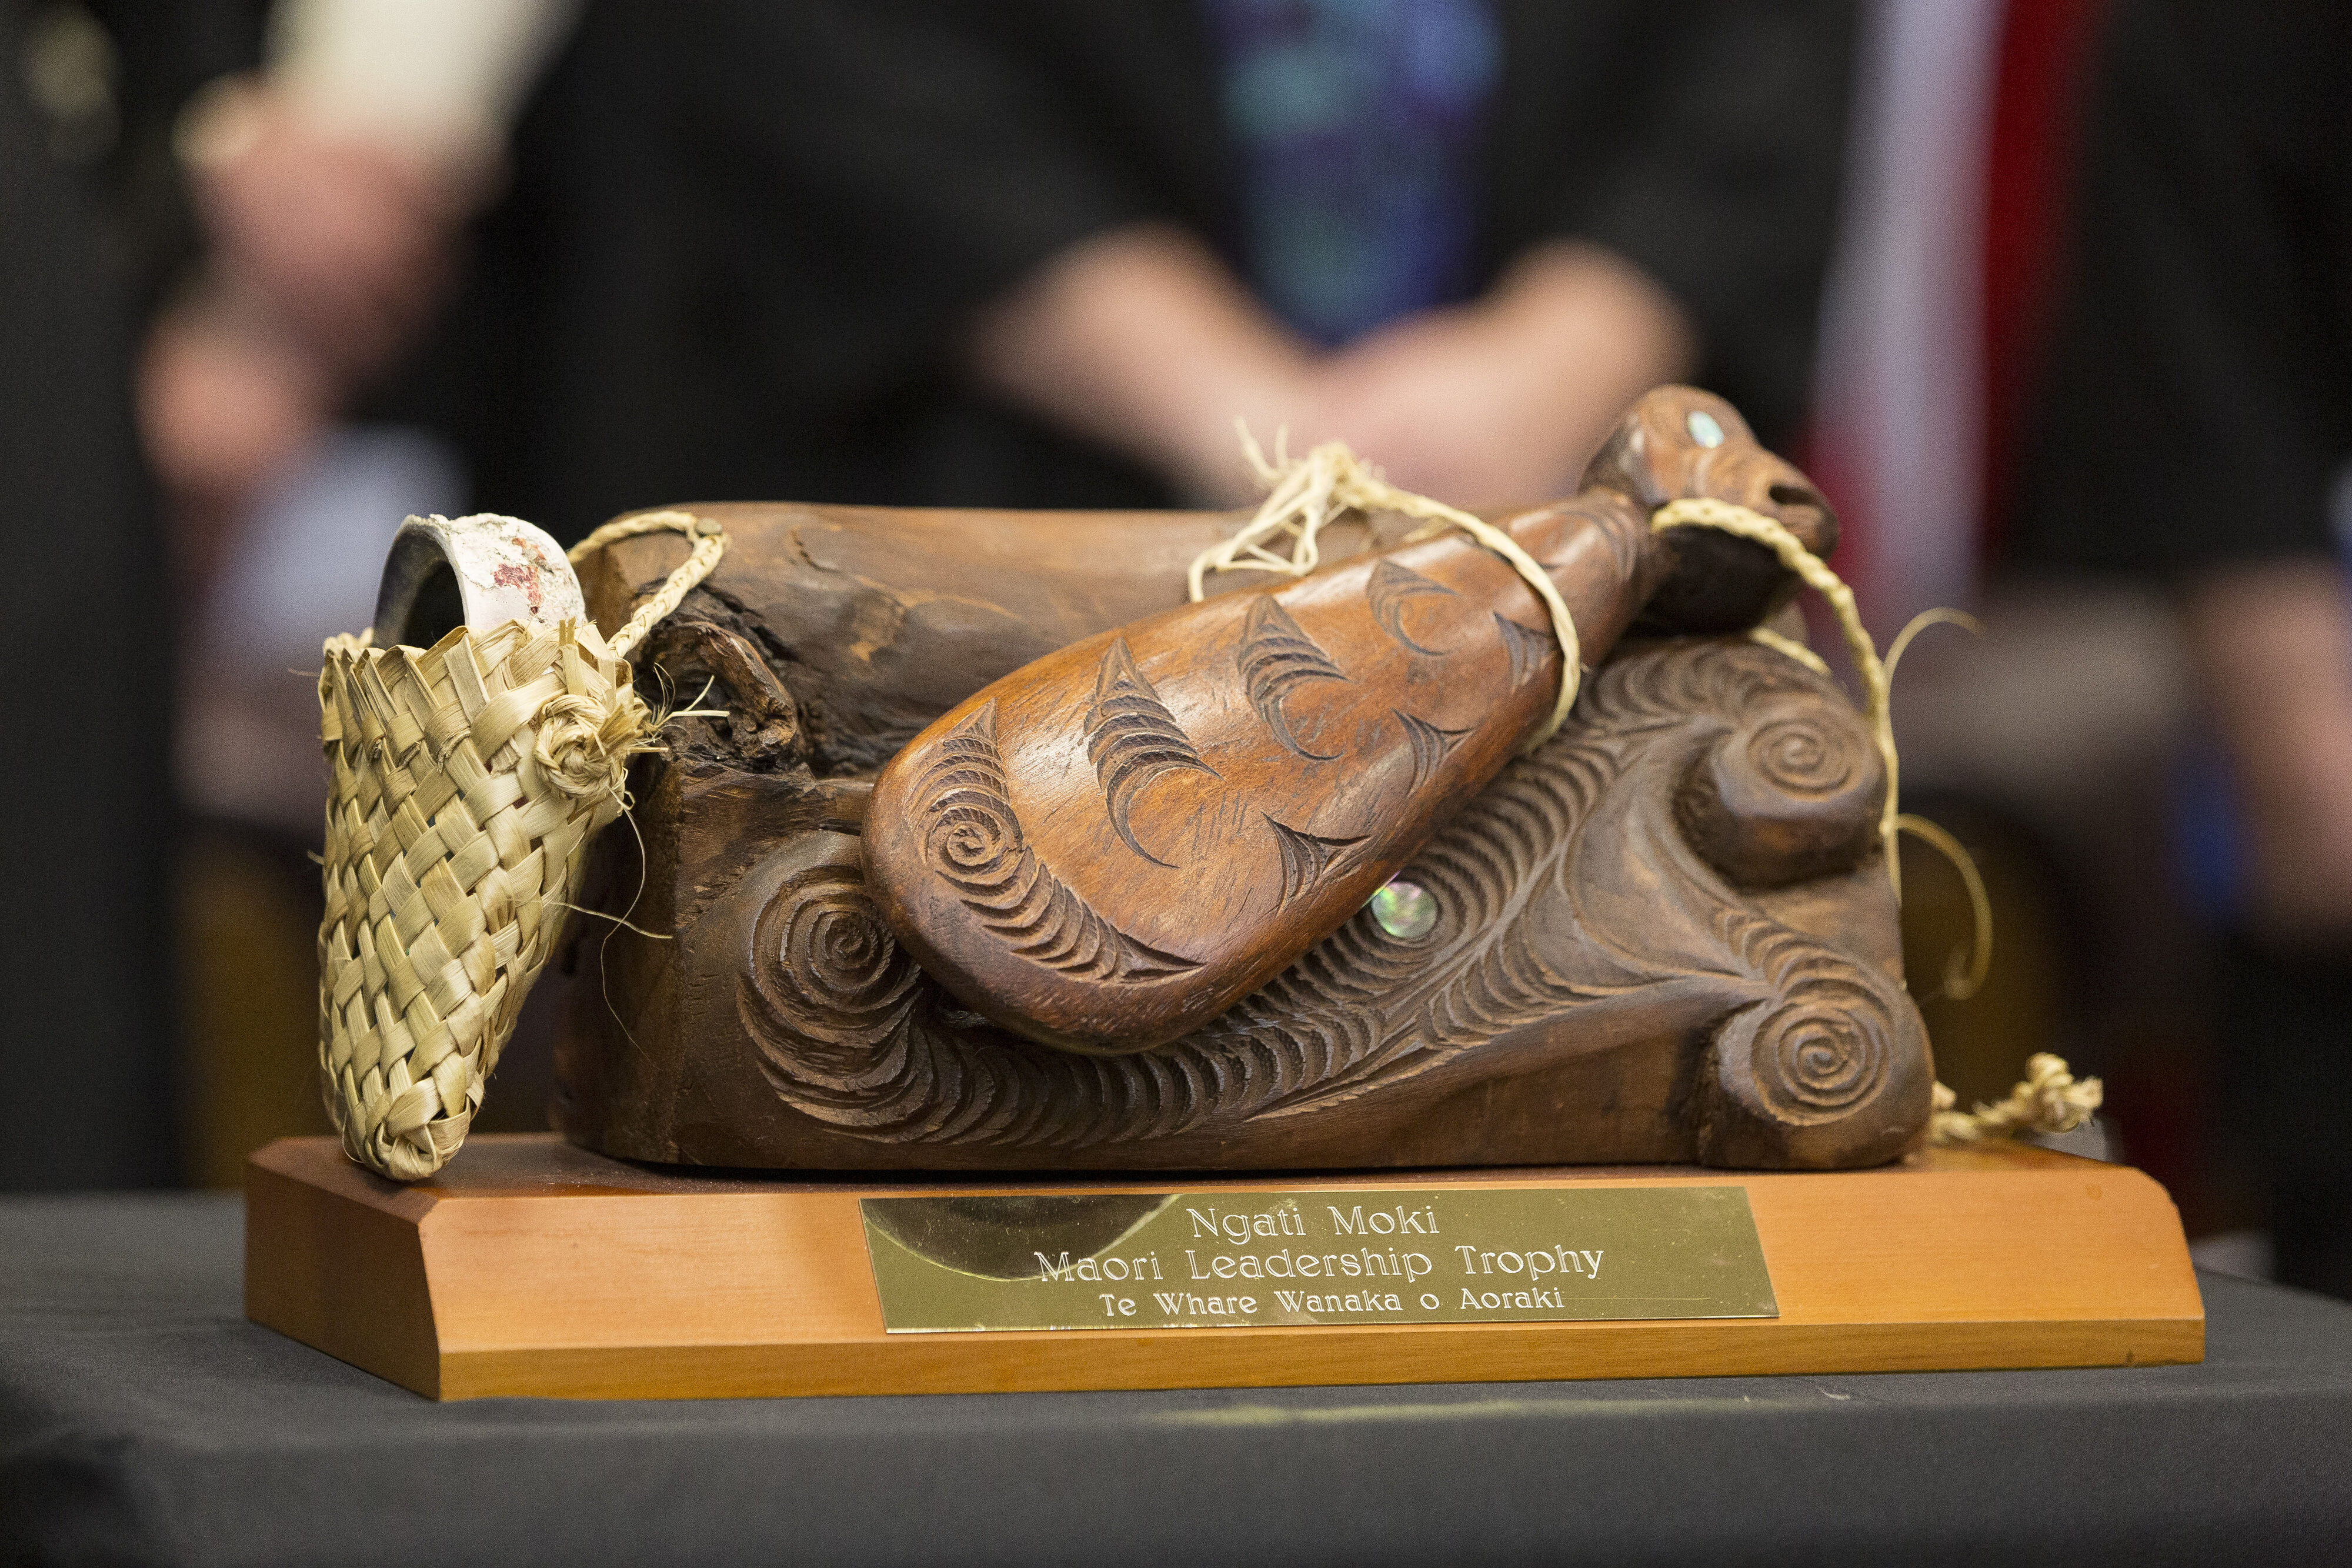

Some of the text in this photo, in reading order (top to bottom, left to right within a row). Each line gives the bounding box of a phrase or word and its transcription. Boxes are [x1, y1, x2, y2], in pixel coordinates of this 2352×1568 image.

[1186, 1205, 1440, 1245] Ngati Moki
[1033, 1244, 1604, 1283] Maori Leadership Trophy
[1099, 1286, 1565, 1317] Te Whare Wanaka o Aoraki
